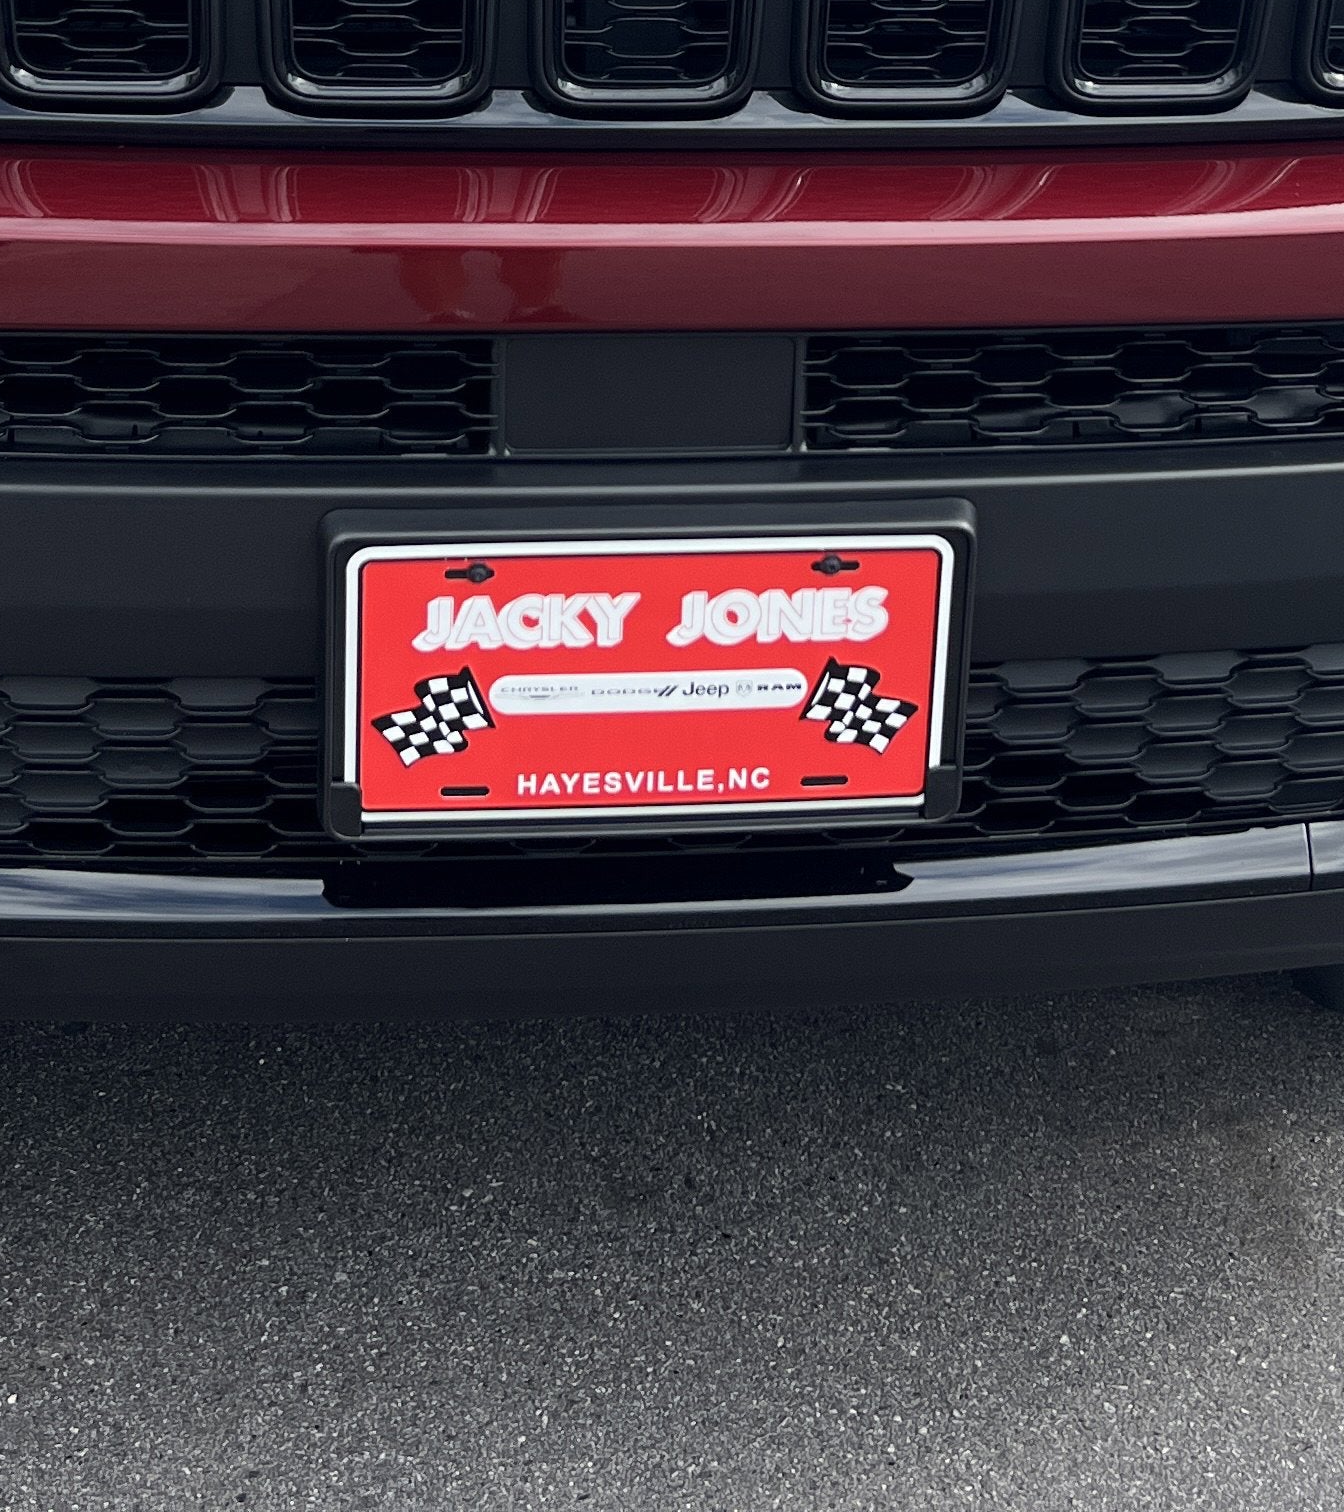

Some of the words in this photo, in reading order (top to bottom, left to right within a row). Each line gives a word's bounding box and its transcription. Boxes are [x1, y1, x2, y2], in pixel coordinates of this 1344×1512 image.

[412, 592, 642, 652] JACKY
[666, 586, 889, 647] JONES
[683, 682, 730, 698] Jeep
[757, 682, 802, 691] RAM
